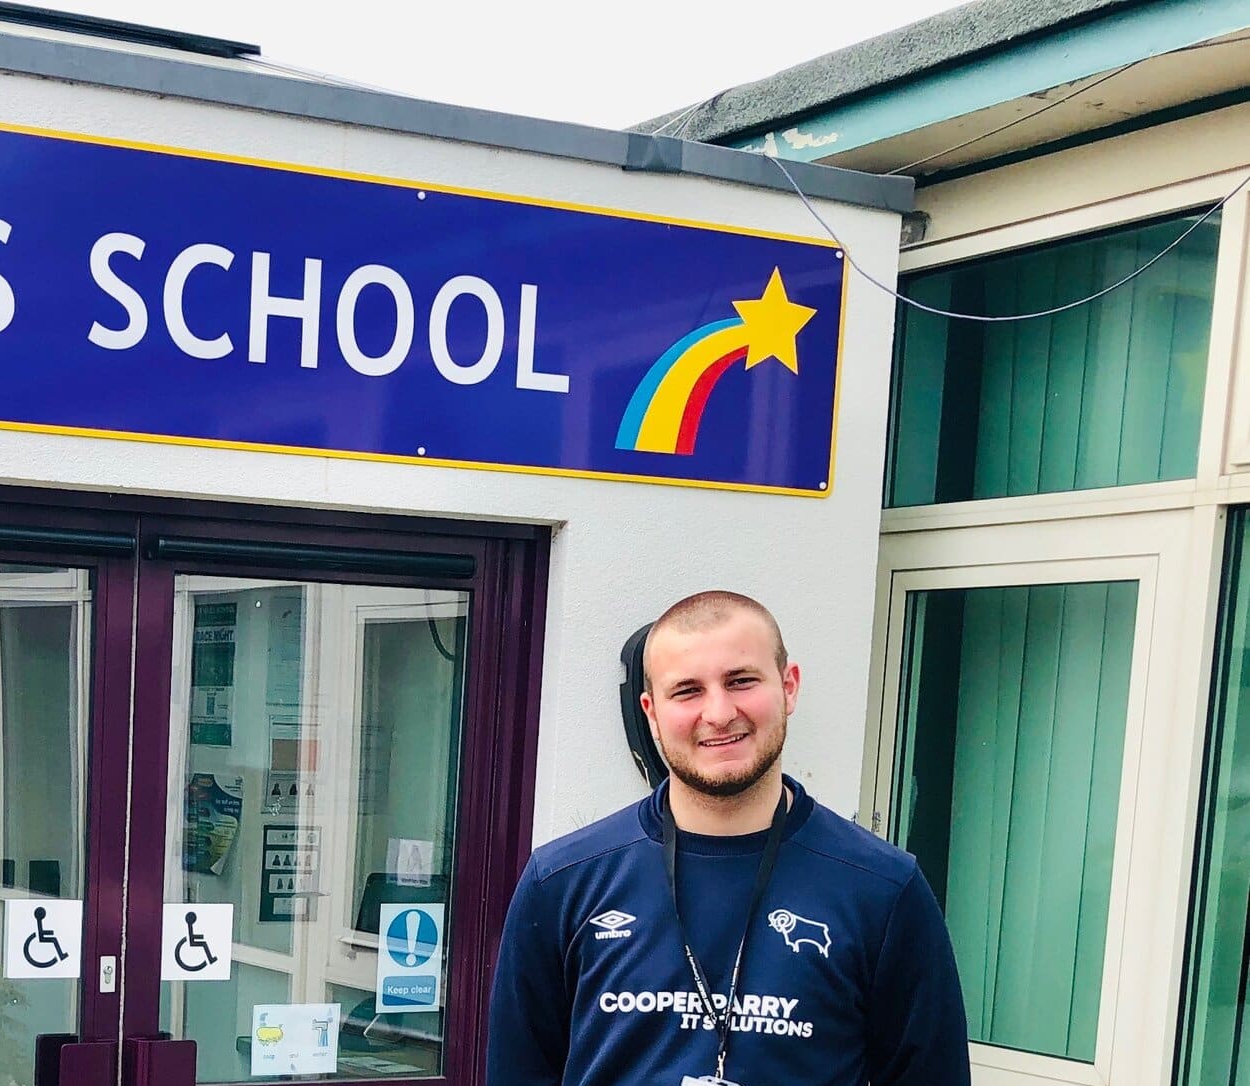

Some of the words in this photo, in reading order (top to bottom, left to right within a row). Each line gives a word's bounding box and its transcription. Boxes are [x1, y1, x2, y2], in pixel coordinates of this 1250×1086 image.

[87, 232, 570, 394] SCHOOL
[594, 929, 632, 940] umbro
[387, 986, 409, 996] Keep
[411, 986, 432, 994] clear
[599, 991, 704, 1014] COOPER
[680, 1013, 700, 1030] IT
[702, 1014, 814, 1038] SLUTIONS
